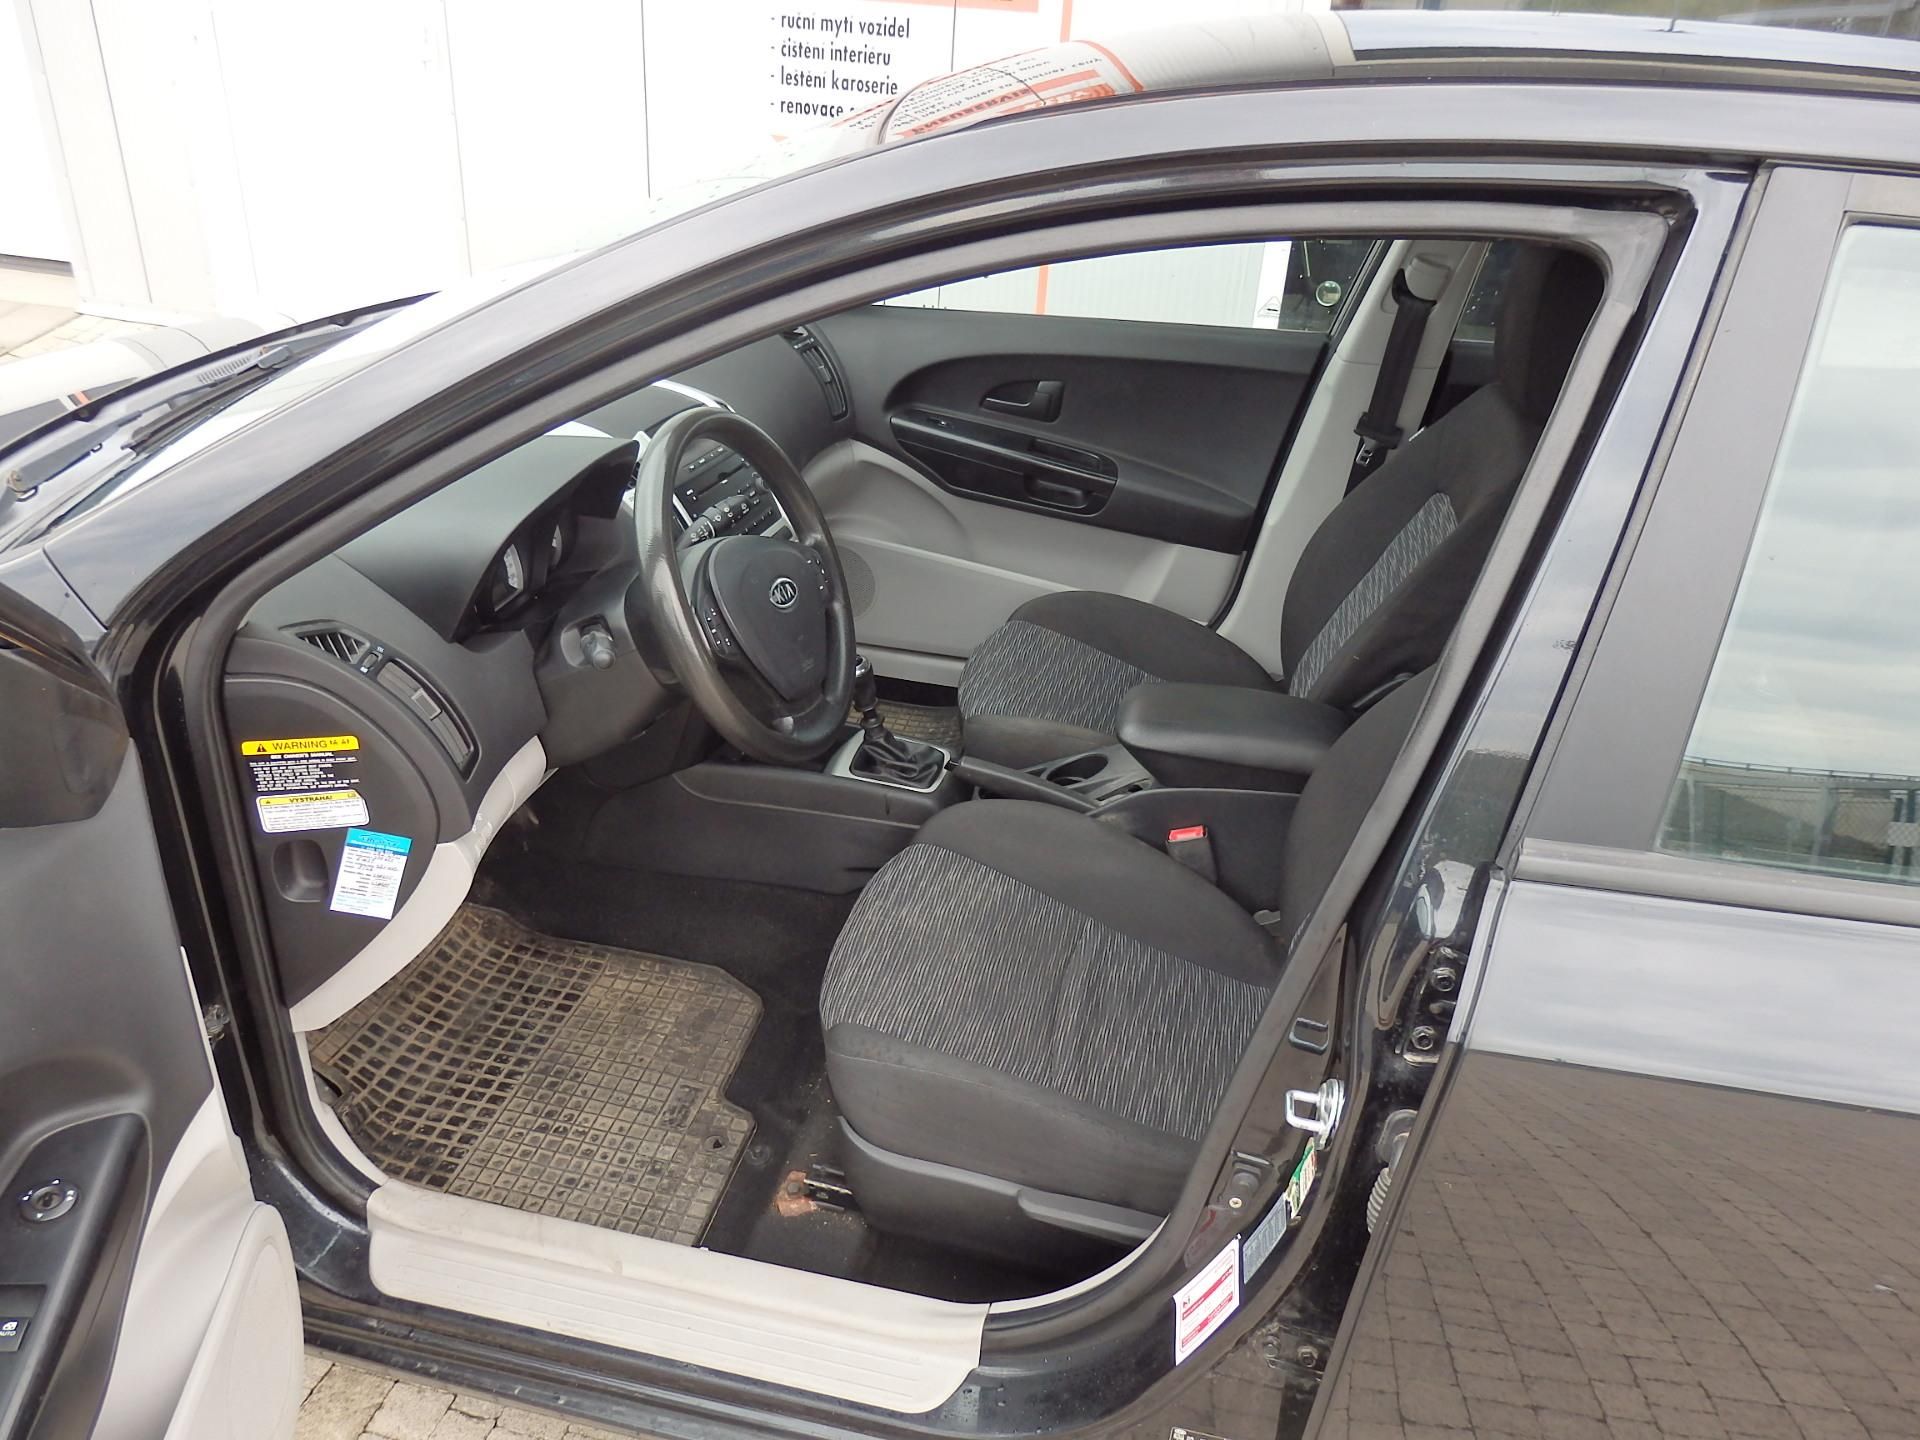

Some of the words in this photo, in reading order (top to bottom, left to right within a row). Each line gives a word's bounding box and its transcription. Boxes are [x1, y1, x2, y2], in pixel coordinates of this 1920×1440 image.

[859, 16, 910, 39] vozidel
[831, 69, 898, 95] karoserie
[780, 100, 844, 118] renovace
[272, 740, 327, 750] WARNING
